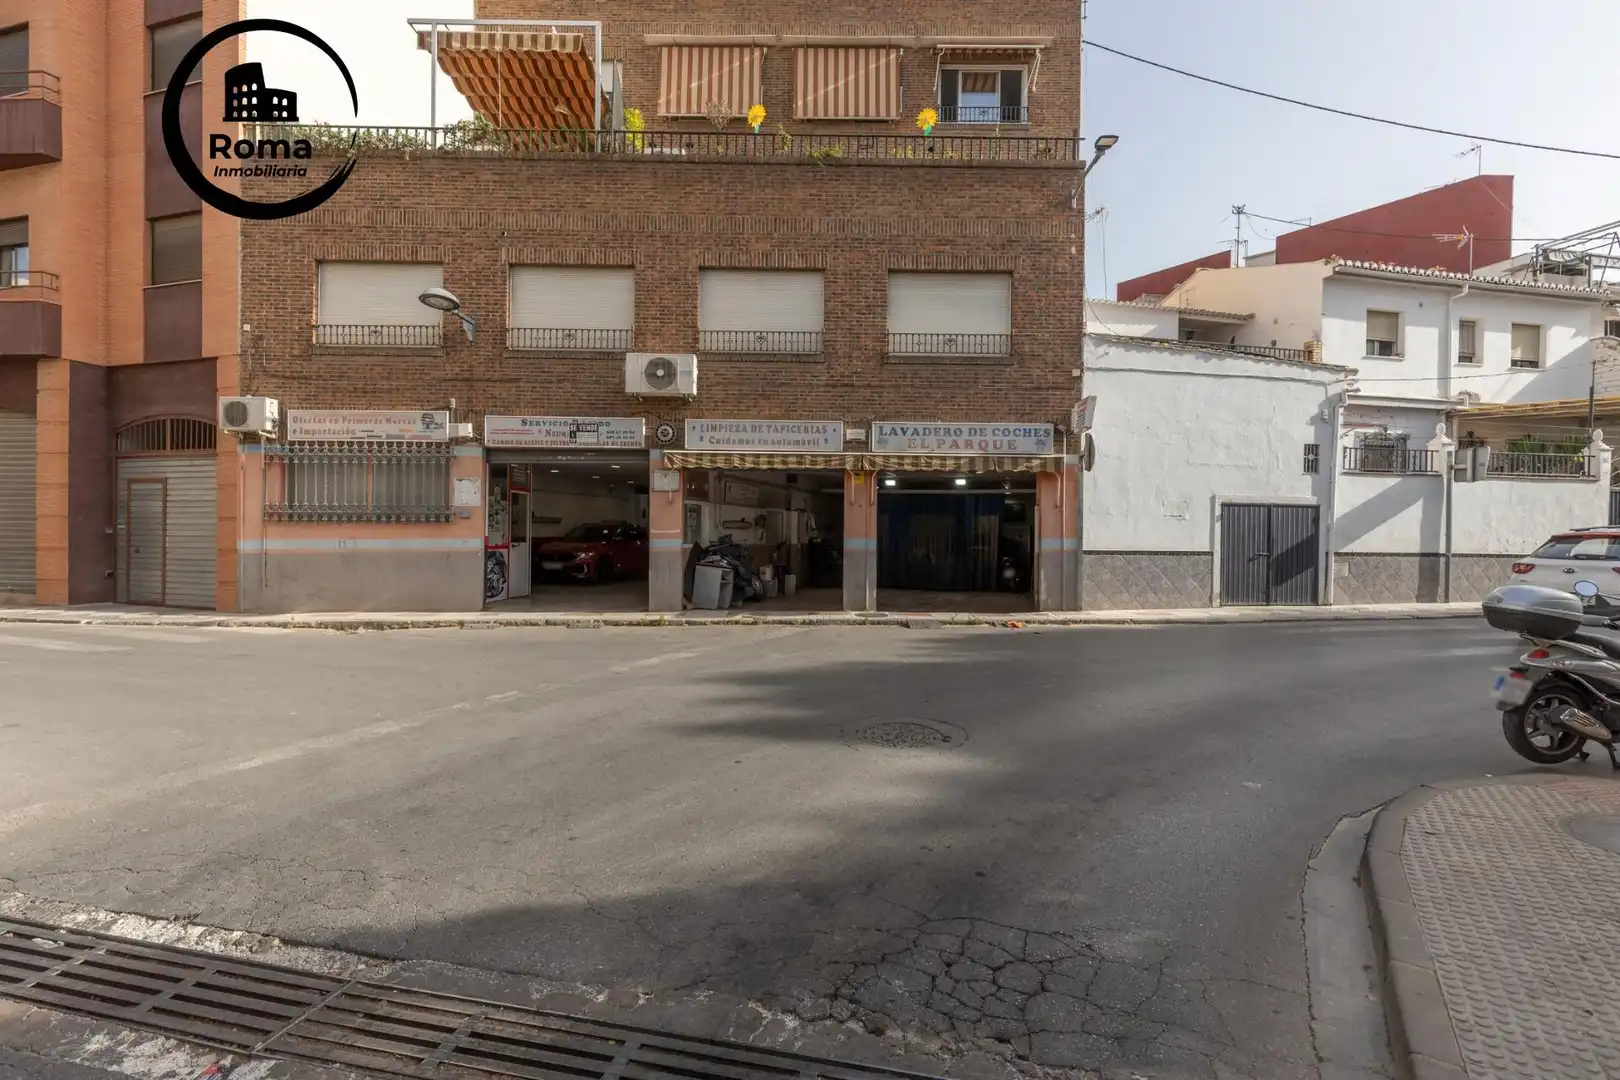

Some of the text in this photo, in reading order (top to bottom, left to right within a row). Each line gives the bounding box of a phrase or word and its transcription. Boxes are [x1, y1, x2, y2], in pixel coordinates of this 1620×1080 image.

[342, 415, 383, 424] Primeras
[700, 423, 748, 434] LIMPIEZA
[751, 425, 764, 434] DE
[877, 425, 1052, 438] LAVADERO DE COCHES
[907, 438, 1018, 452] EL PARQUE
